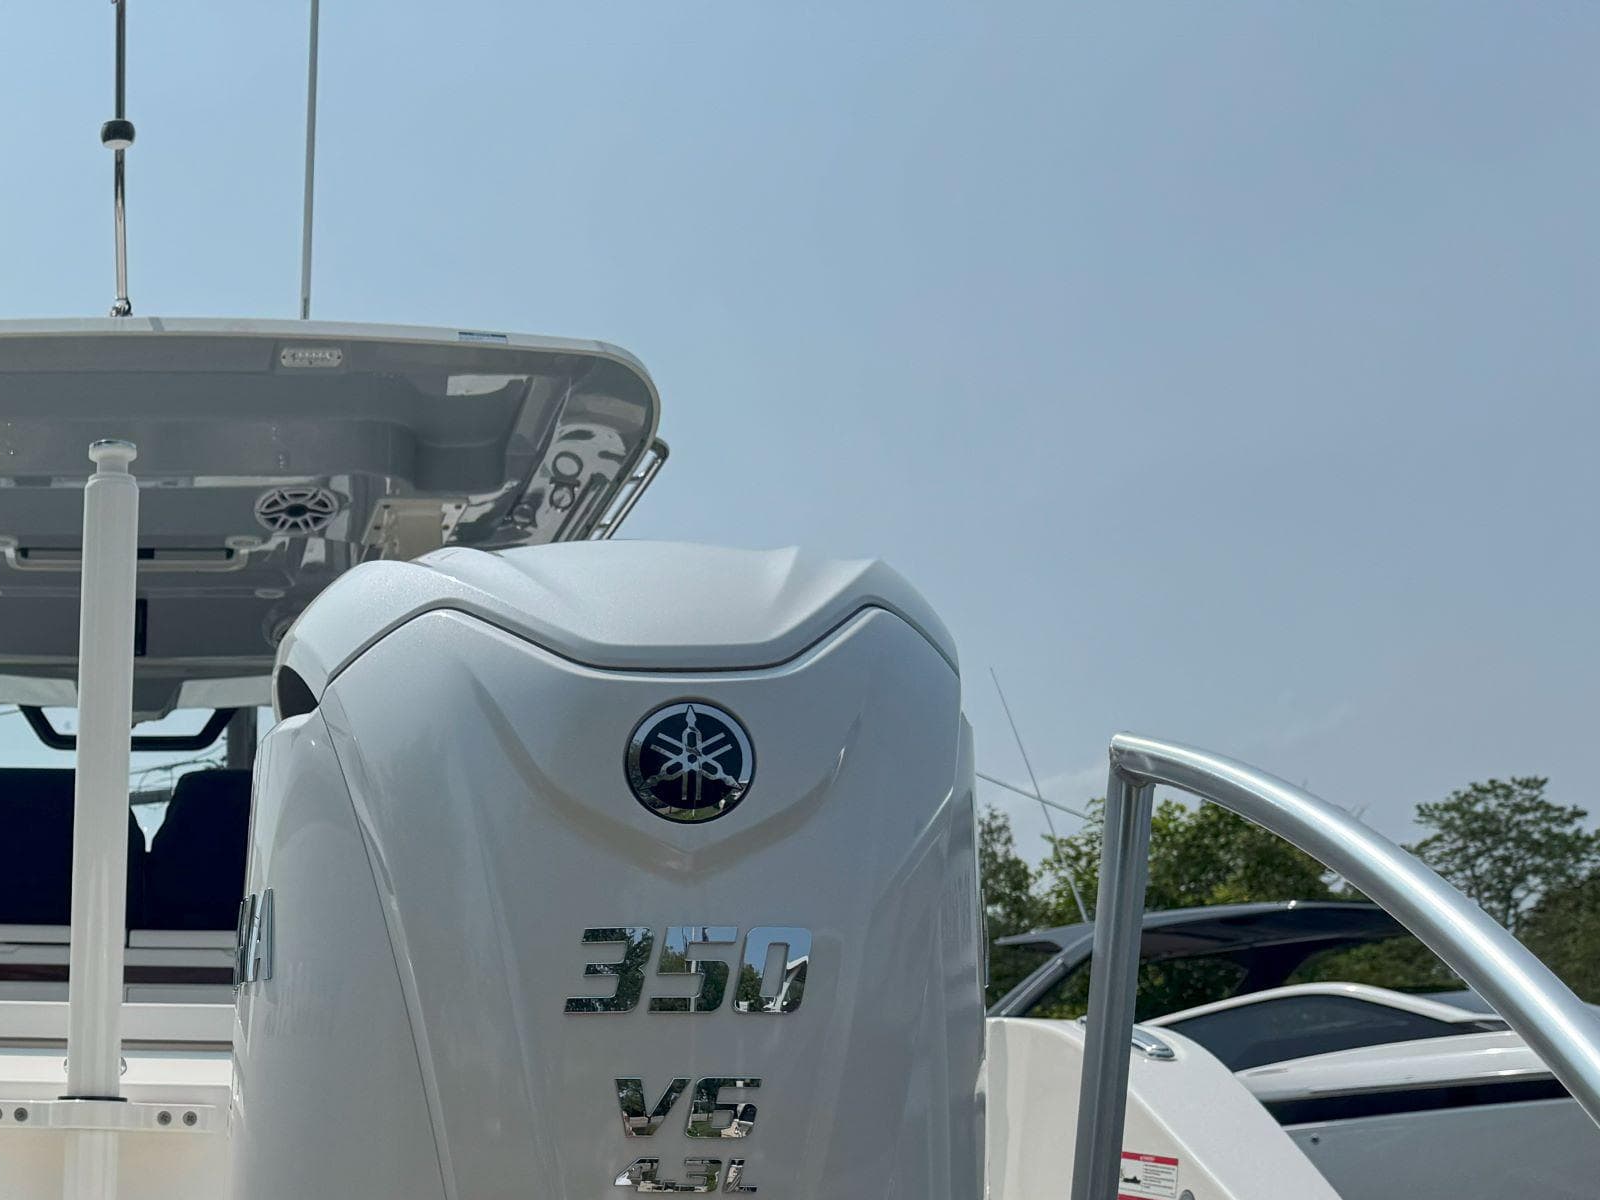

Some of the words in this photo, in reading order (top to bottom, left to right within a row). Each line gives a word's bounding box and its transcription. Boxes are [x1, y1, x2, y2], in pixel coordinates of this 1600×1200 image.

[563, 925, 813, 1016] 350
[613, 1076, 763, 1139] V6
[613, 1157, 758, 1193] 4.3L
